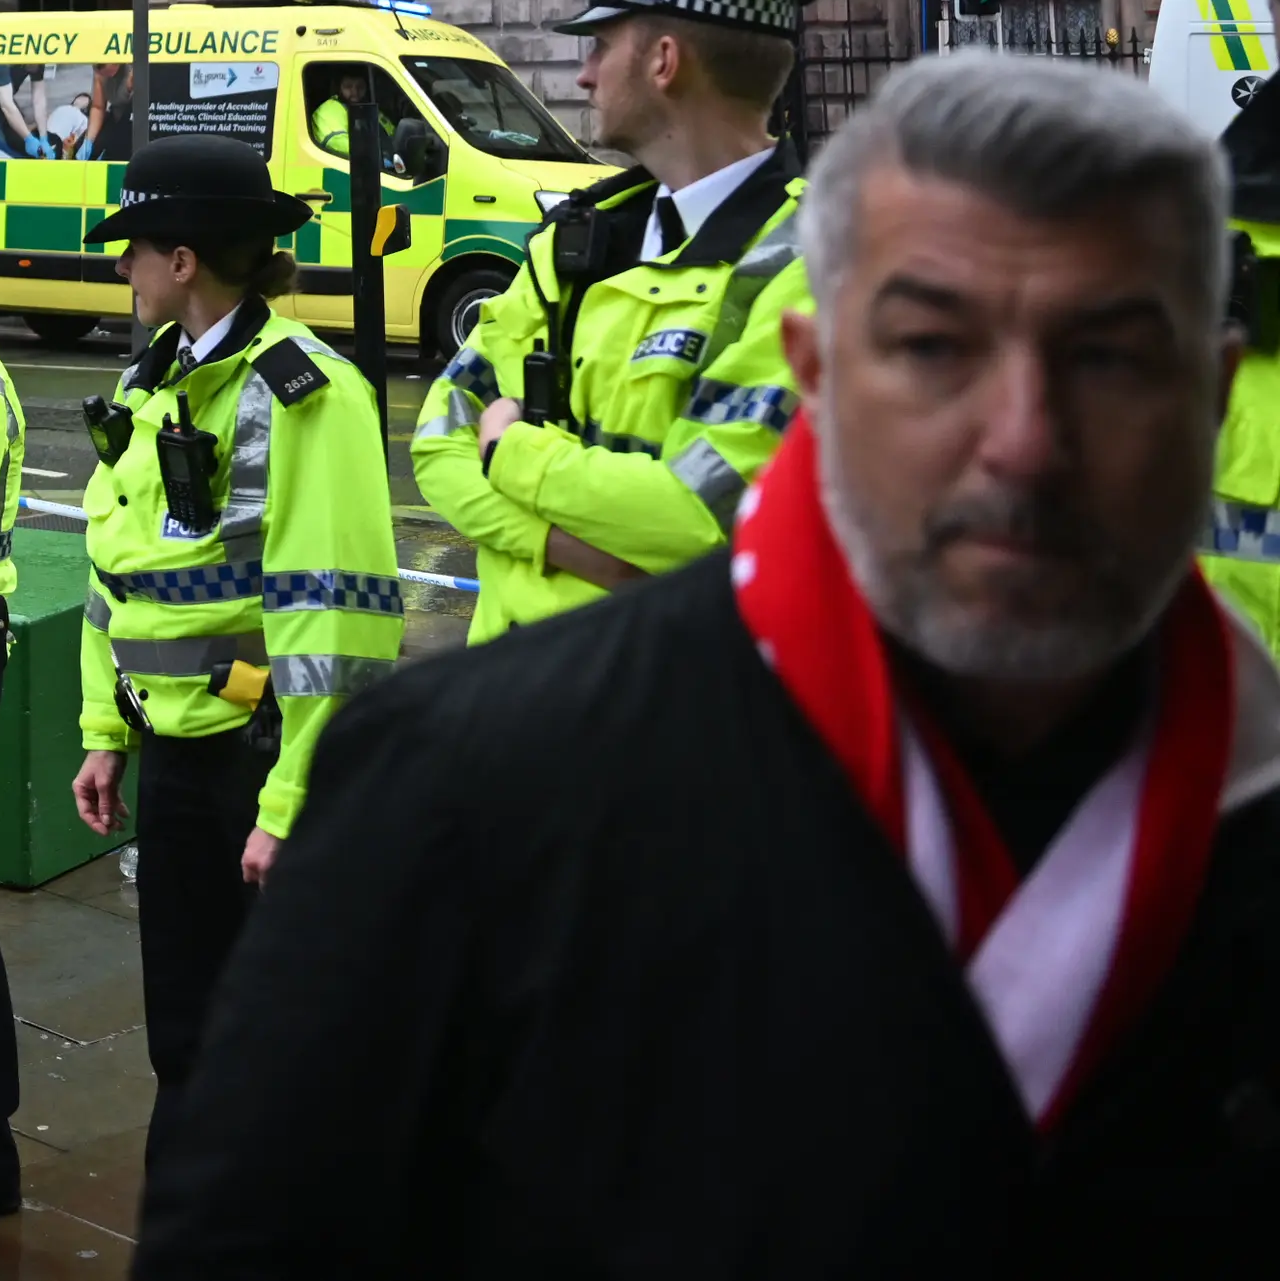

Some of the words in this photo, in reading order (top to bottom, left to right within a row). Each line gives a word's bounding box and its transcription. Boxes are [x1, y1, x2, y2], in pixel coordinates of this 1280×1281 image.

[148, 102, 155, 110] A
[156, 102, 185, 112] leading
[185, 102, 216, 113] provider
[217, 102, 226, 112] of
[226, 102, 268, 111] Accredited
[177, 113, 197, 122] Care,
[198, 112, 228, 121] Clinical
[228, 112, 267, 121] Education
[159, 123, 198, 133] Workplace
[198, 123, 216, 132] First
[217, 123, 231, 132] Aid
[232, 123, 266, 133] Training
[284, 372, 314, 393] 2633
